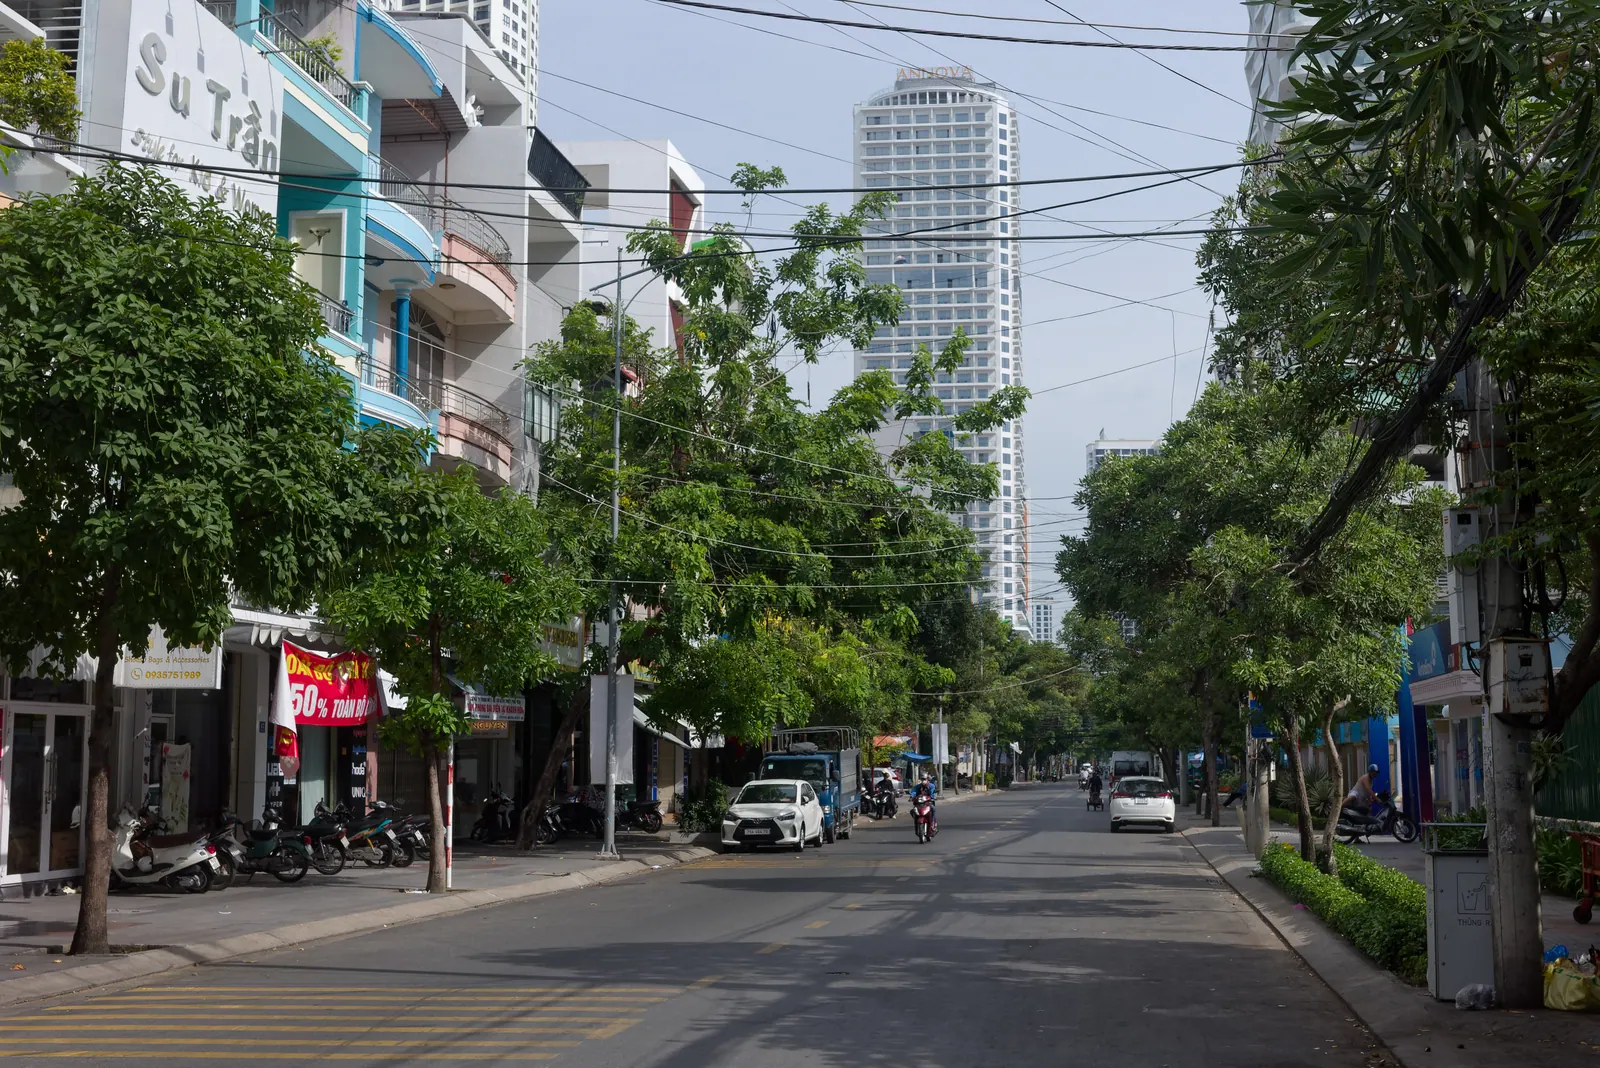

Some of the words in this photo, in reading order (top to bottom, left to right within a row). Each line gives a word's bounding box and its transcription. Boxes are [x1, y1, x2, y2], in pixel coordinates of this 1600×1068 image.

[896, 65, 976, 82] ANNOVA
[135, 32, 191, 119] Su
[206, 79, 278, 179] Trần
[131, 128, 166, 163] Style
[215, 176, 230, 204] &
[231, 183, 266, 219] Wom
[148, 656, 164, 665] Bags
[173, 656, 210, 664] Accessories
[145, 671, 201, 680] 0935751989
[290, 683, 329, 719] 50%
[331, 695, 356, 719] TOÀN
[354, 694, 367, 722] BỘ
[1457, 917, 1482, 927] THÙNG
[1485, 919, 1493, 927] R
